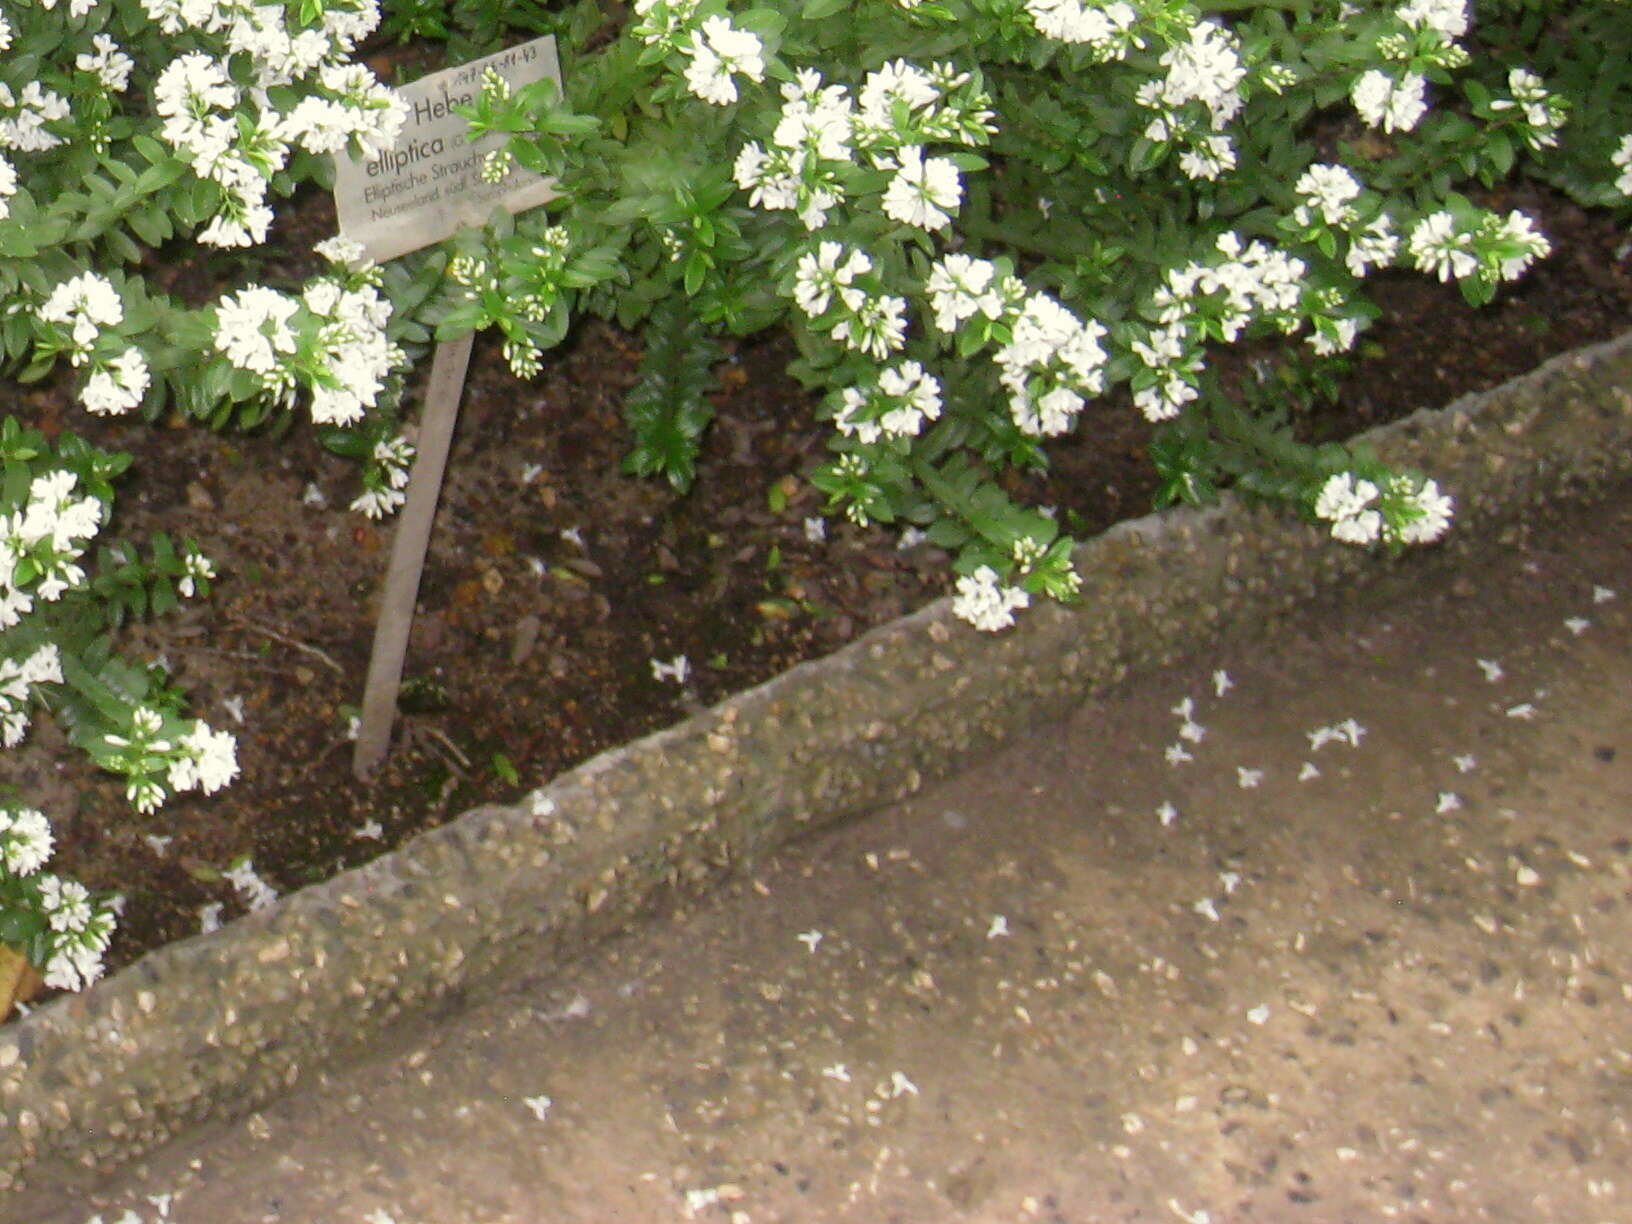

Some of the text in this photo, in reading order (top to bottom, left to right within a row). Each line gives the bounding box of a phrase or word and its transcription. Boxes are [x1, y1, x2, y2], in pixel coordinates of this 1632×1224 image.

[413, 90, 473, 126] Hebe
[367, 138, 444, 177] elliptica
[364, 173, 427, 204] Elliptische
